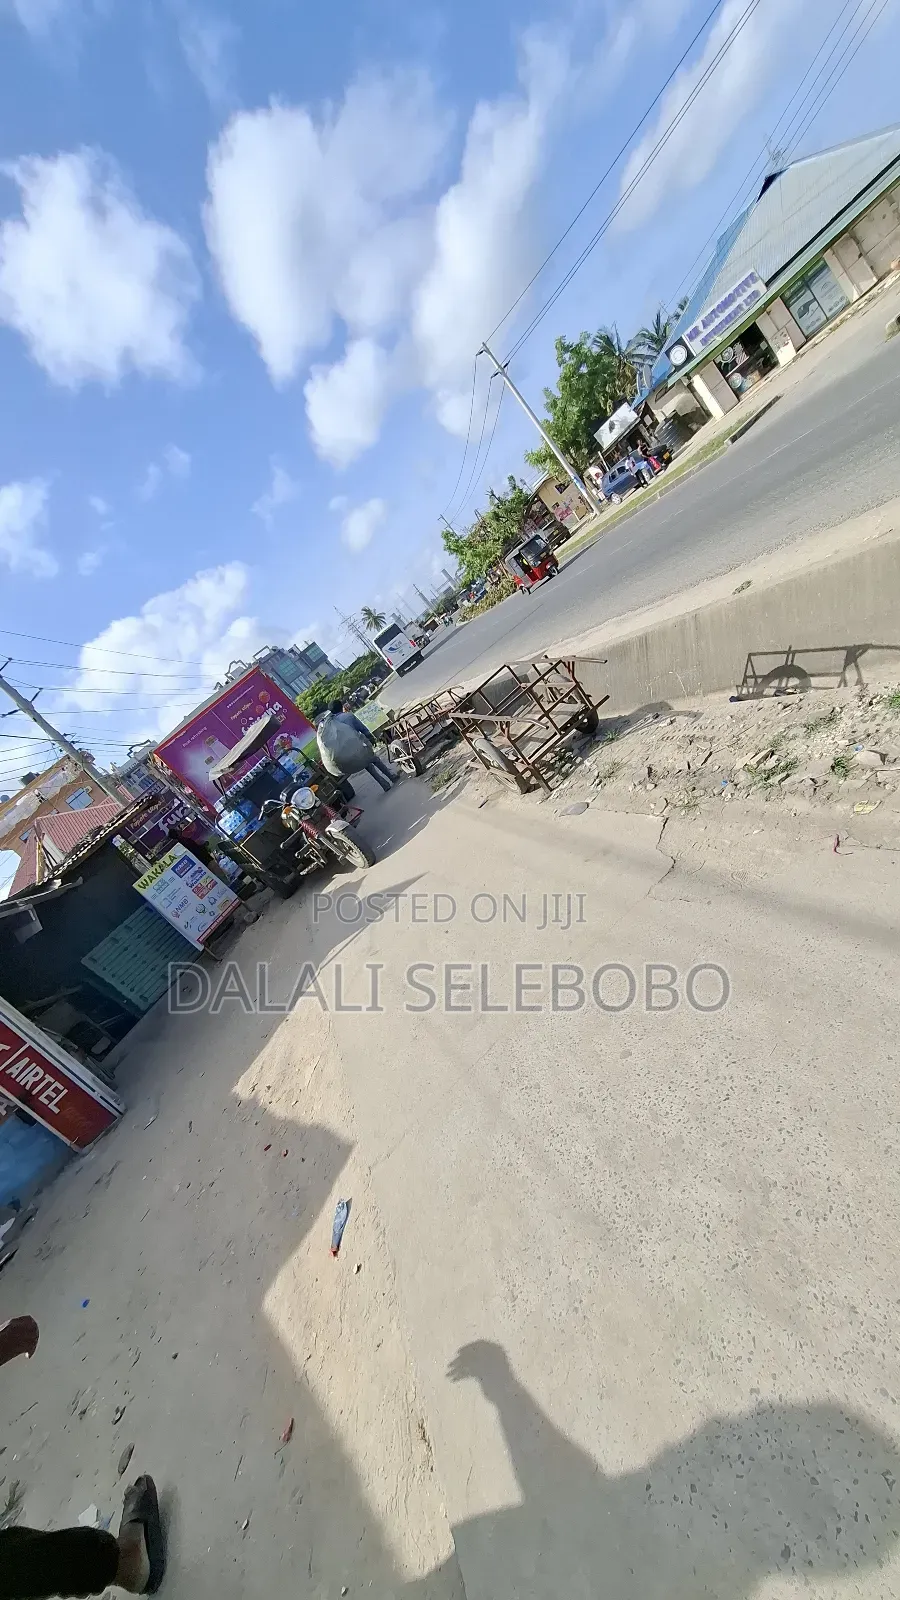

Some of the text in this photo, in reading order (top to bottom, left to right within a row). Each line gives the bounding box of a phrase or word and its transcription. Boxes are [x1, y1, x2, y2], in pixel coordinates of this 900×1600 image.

[701, 272, 758, 330] AUTOMOTIVE
[137, 854, 178, 890] WAKALA
[5, 1057, 69, 1115] AIRTEL
